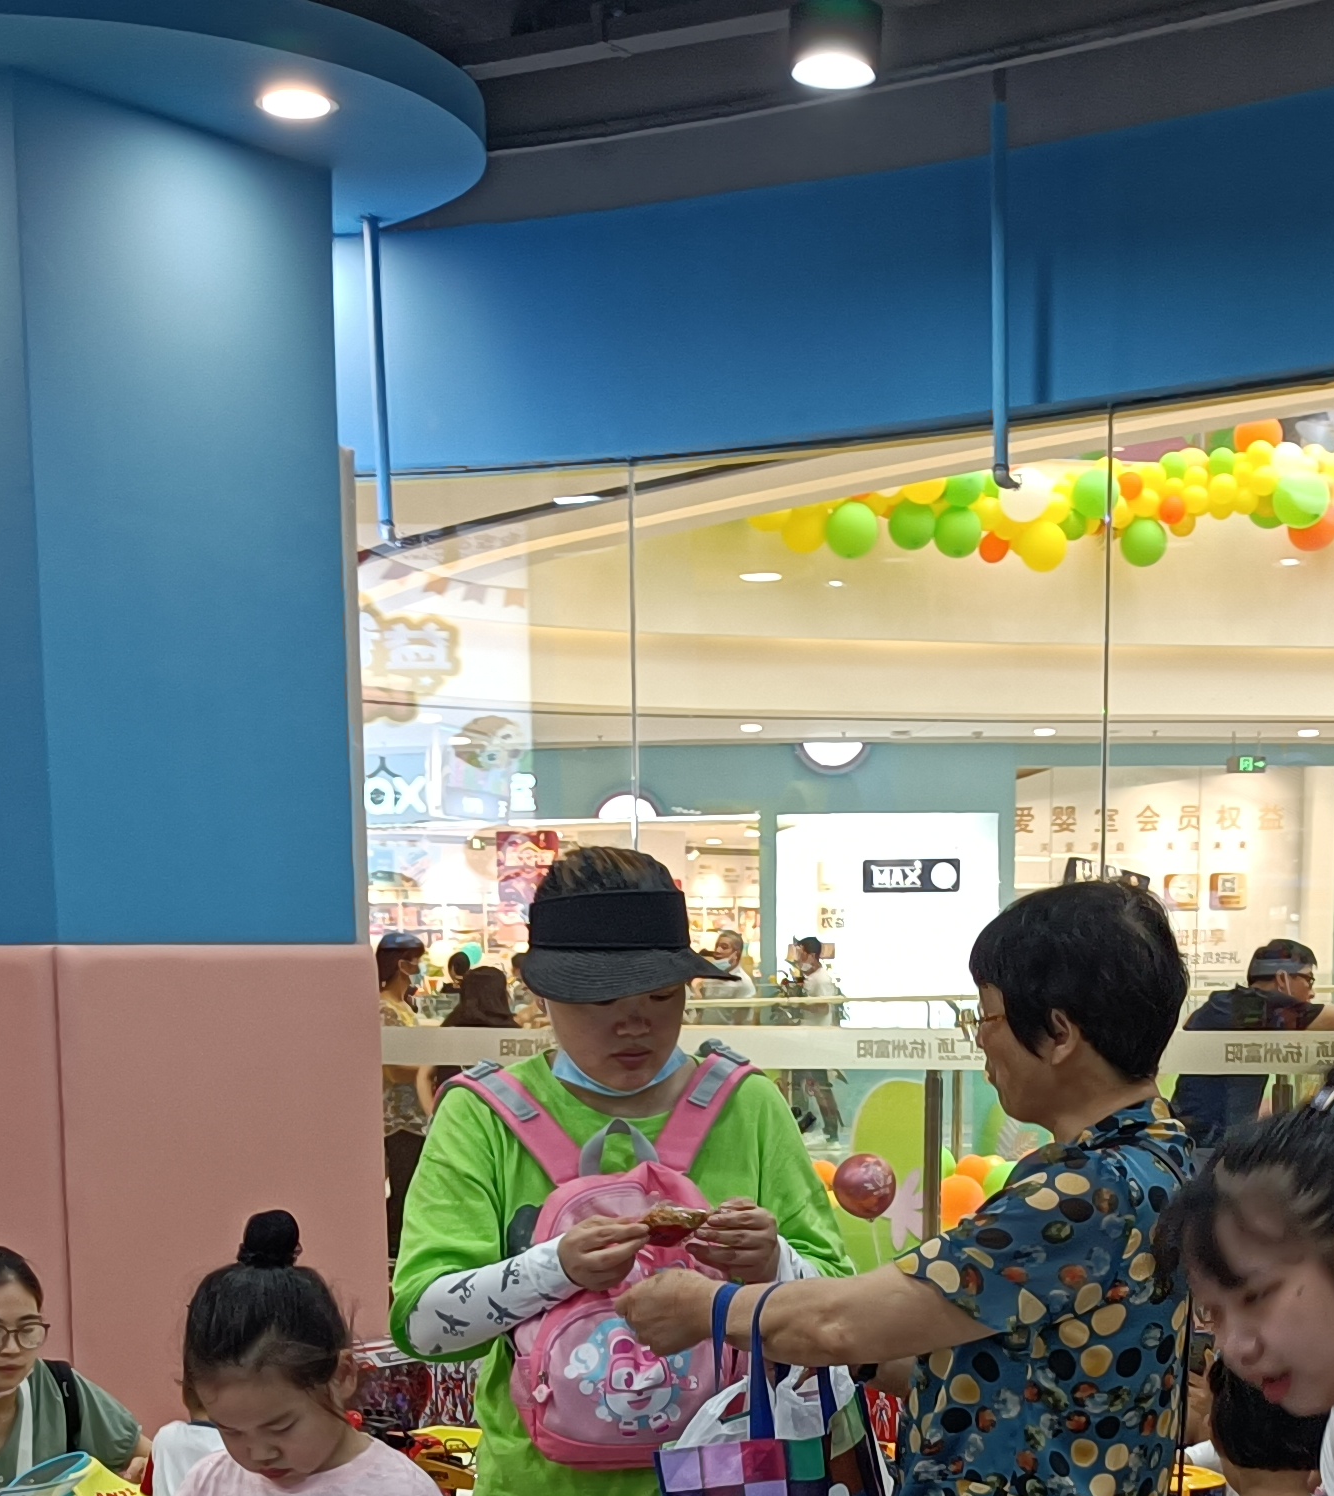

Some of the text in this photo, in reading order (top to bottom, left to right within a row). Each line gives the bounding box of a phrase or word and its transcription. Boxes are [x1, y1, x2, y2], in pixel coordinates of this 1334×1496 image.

[1014, 804, 1285, 834] 爱婴室会员权益
